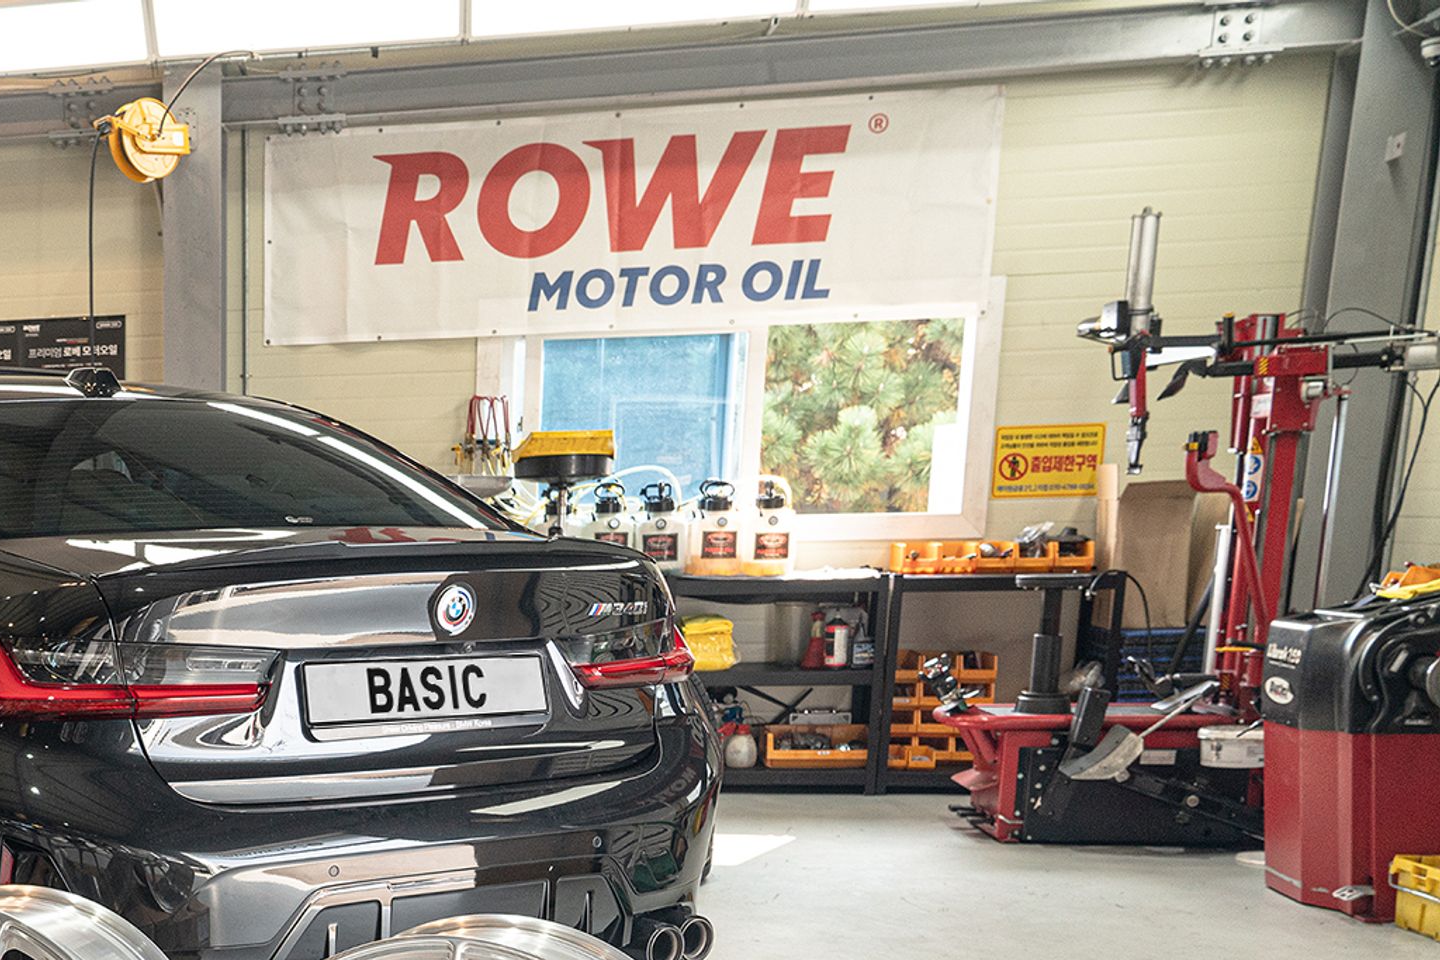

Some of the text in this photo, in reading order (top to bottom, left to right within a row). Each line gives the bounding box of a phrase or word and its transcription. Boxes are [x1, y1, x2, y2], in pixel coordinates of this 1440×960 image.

[373, 124, 851, 265] ROWE
[527, 259, 830, 312] MOTOR OIL
[366, 663, 487, 714] BASIC
